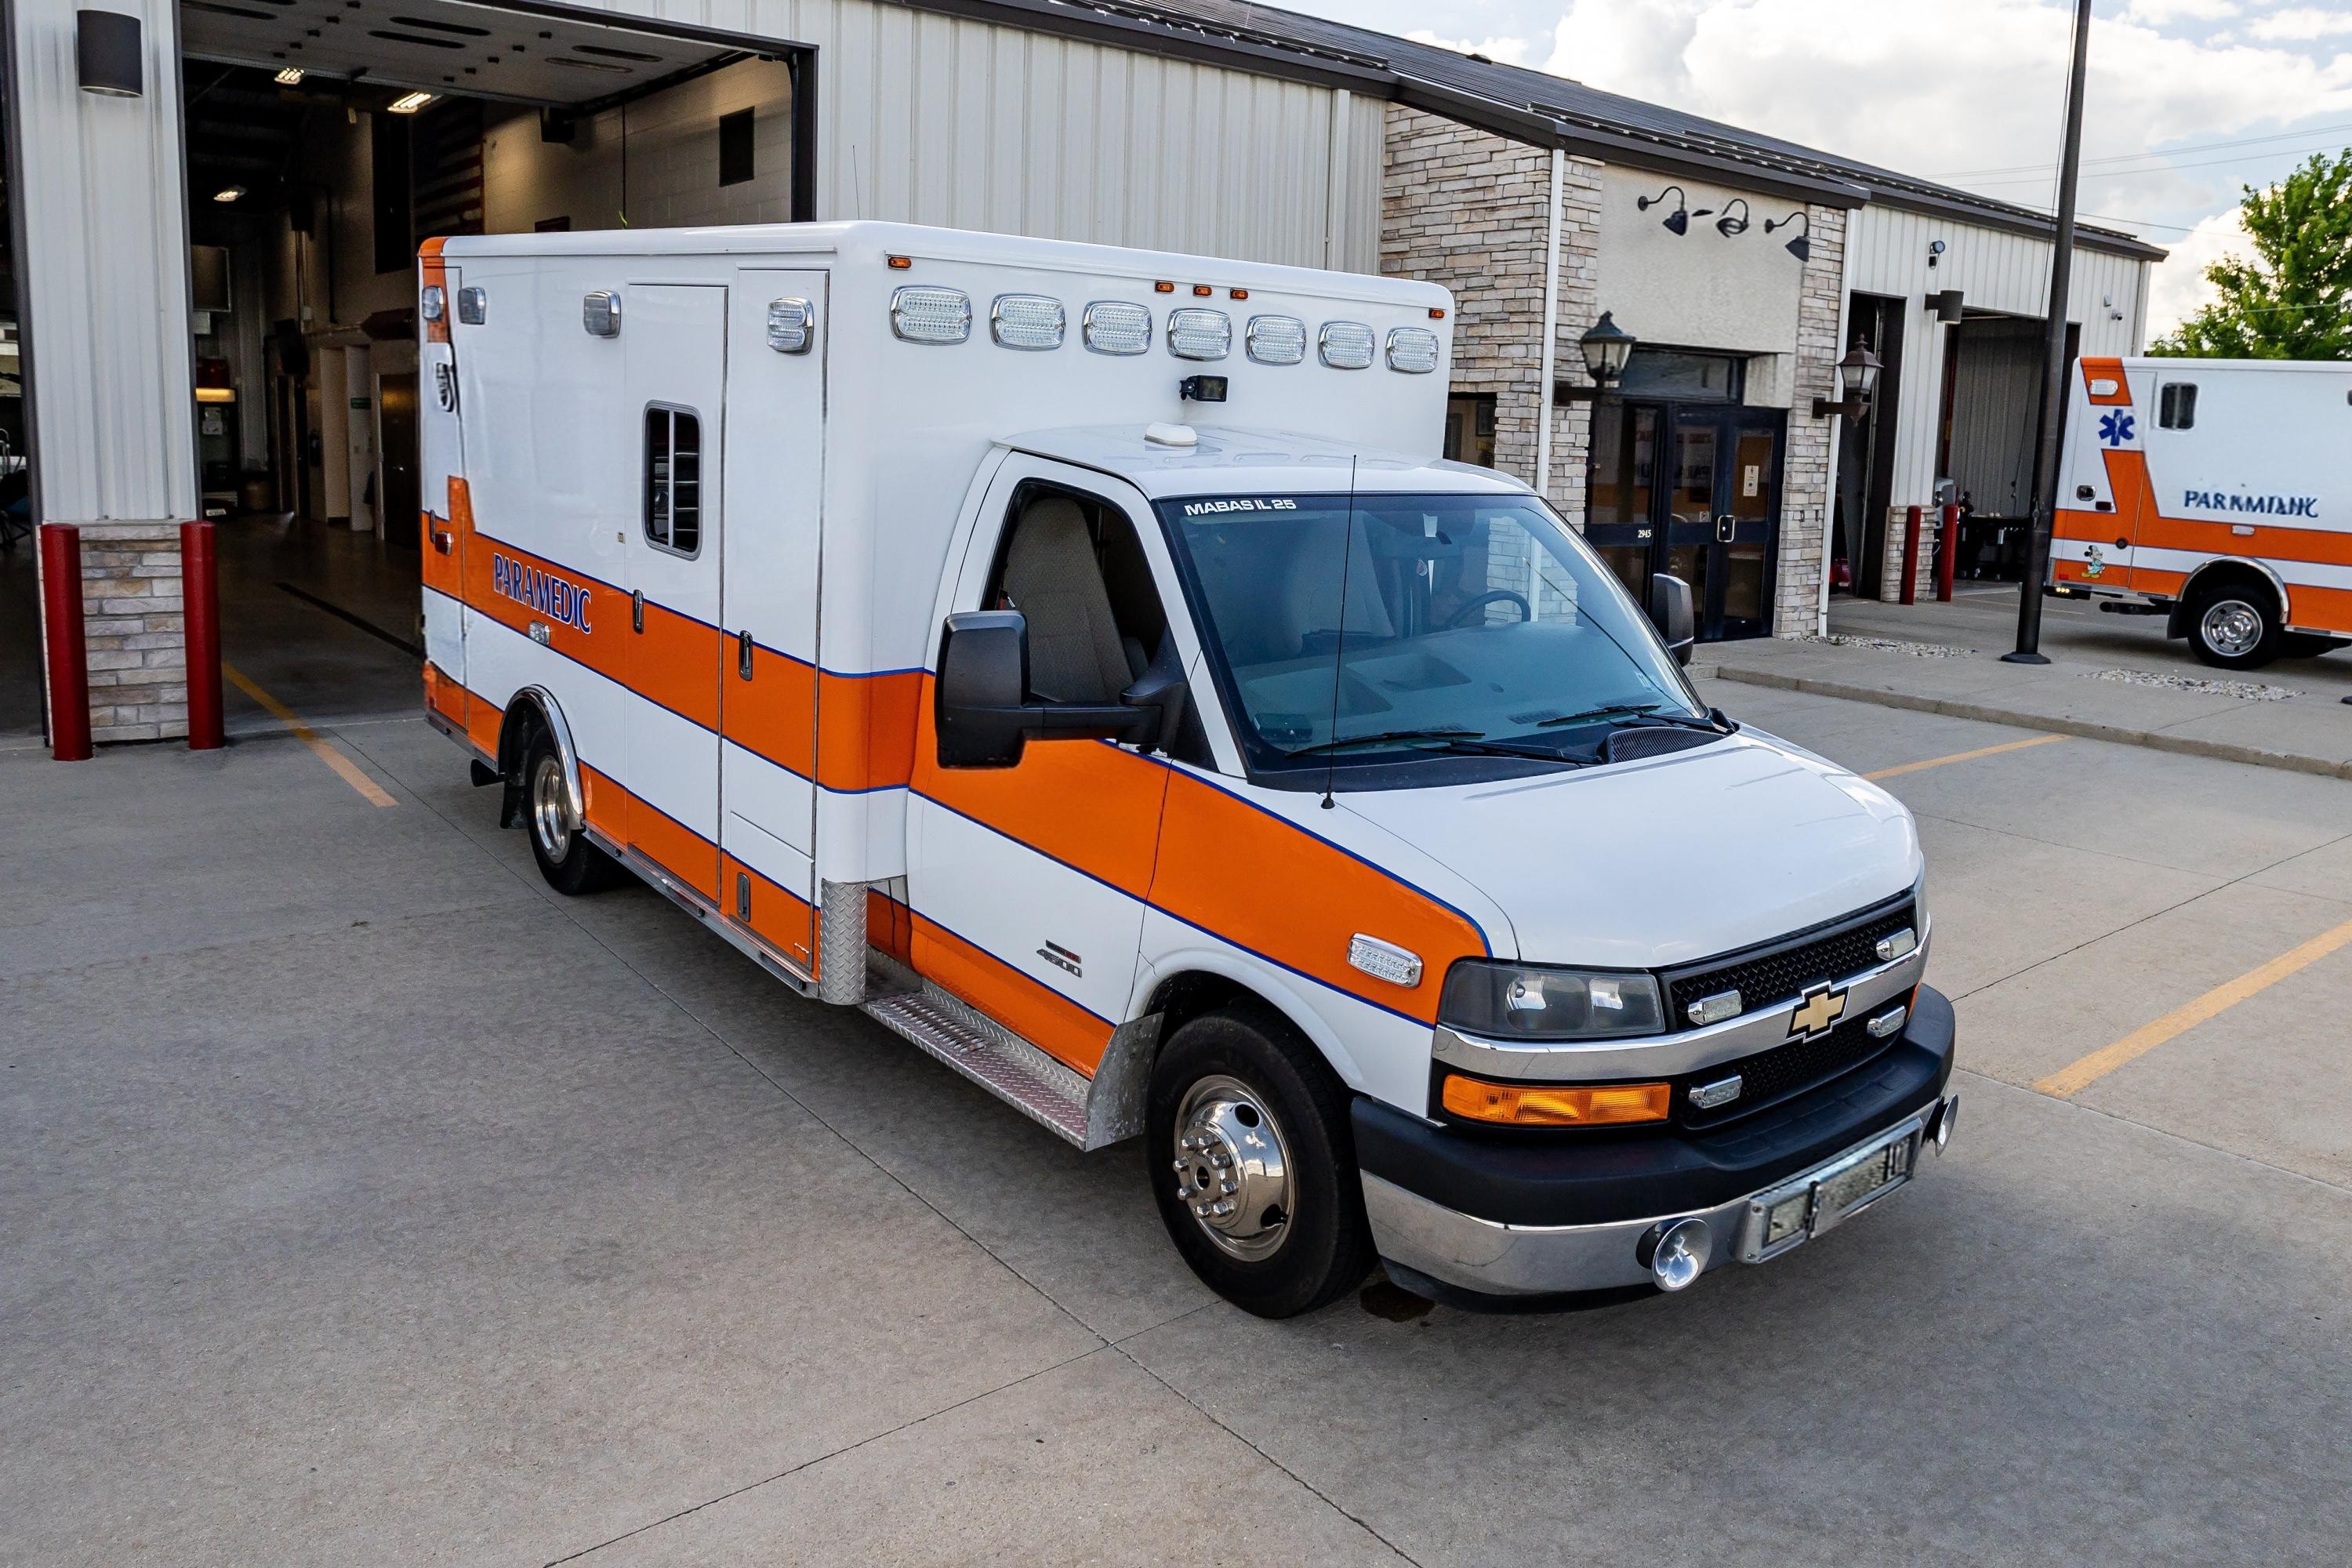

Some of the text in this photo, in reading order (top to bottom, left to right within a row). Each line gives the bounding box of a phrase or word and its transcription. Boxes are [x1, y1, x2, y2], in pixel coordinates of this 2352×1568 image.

[1184, 499, 1298, 516] MABAS IL 25
[1637, 529, 1652, 539] 2945
[493, 552, 592, 635] PARAMEDIC
[1036, 948, 1083, 978] 4500
